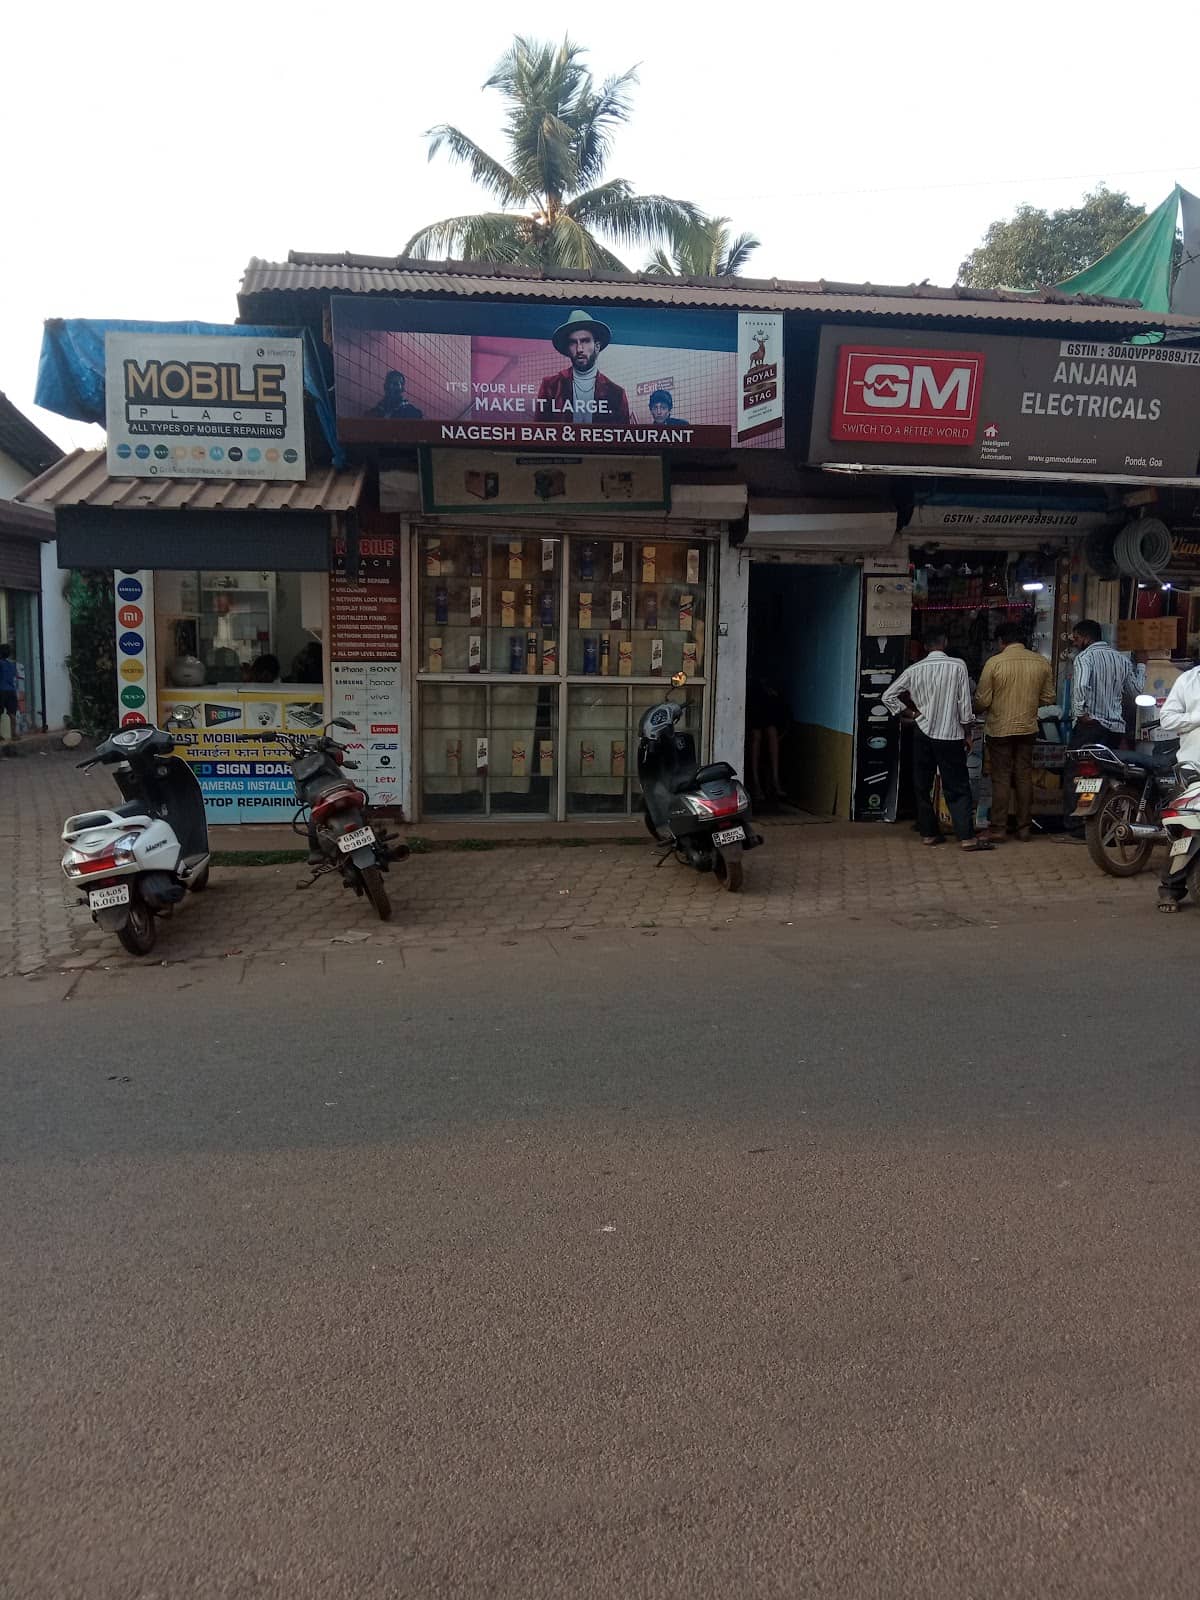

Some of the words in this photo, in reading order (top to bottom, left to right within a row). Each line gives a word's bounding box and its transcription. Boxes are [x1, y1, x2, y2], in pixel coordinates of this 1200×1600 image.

[1067, 343, 1098, 356] GSTIN
[746, 368, 775, 385] ROYAL
[1053, 361, 1137, 387] ANJANA
[125, 361, 285, 403] MOBILE
[473, 383, 506, 393] YOUR
[863, 364, 971, 410] GM
[749, 389, 771, 405] STAG
[475, 397, 526, 412] MAKE
[532, 398, 547, 412] IT
[551, 399, 612, 414] LARGE.
[1021, 391, 1161, 420] ELECTRICALS
[140, 408, 273, 422] PLACE
[132, 424, 148, 432] ALL
[151, 424, 180, 433] TYPES
[182, 424, 195, 433] OF
[197, 425, 231, 434] MOBILE
[233, 426, 282, 436] REPAIRING
[441, 425, 515, 441] NAGESH
[521, 427, 557, 441] BAR
[561, 425, 576, 441] &
[580, 428, 694, 443] RESTAURANT
[842, 423, 877, 434] SWITCH
[880, 424, 892, 435] TO
[903, 426, 934, 437] BETTER
[936, 427, 969, 438] WORLD
[1027, 454, 1097, 465] www.gmmodular.com
[1149, 457, 1163, 467] Goa
[944, 514, 974, 523] GSTIN
[336, 538, 393, 556] MBILE
[337, 559, 393, 568] PACE
[193, 764, 213, 775] ED
[216, 763, 251, 775] SIGN
[255, 763, 293, 775] BOAR
[200, 780, 244, 791] AMERAS
[247, 780, 295, 791] INSTALLA
[203, 797, 233, 807] PTOP
